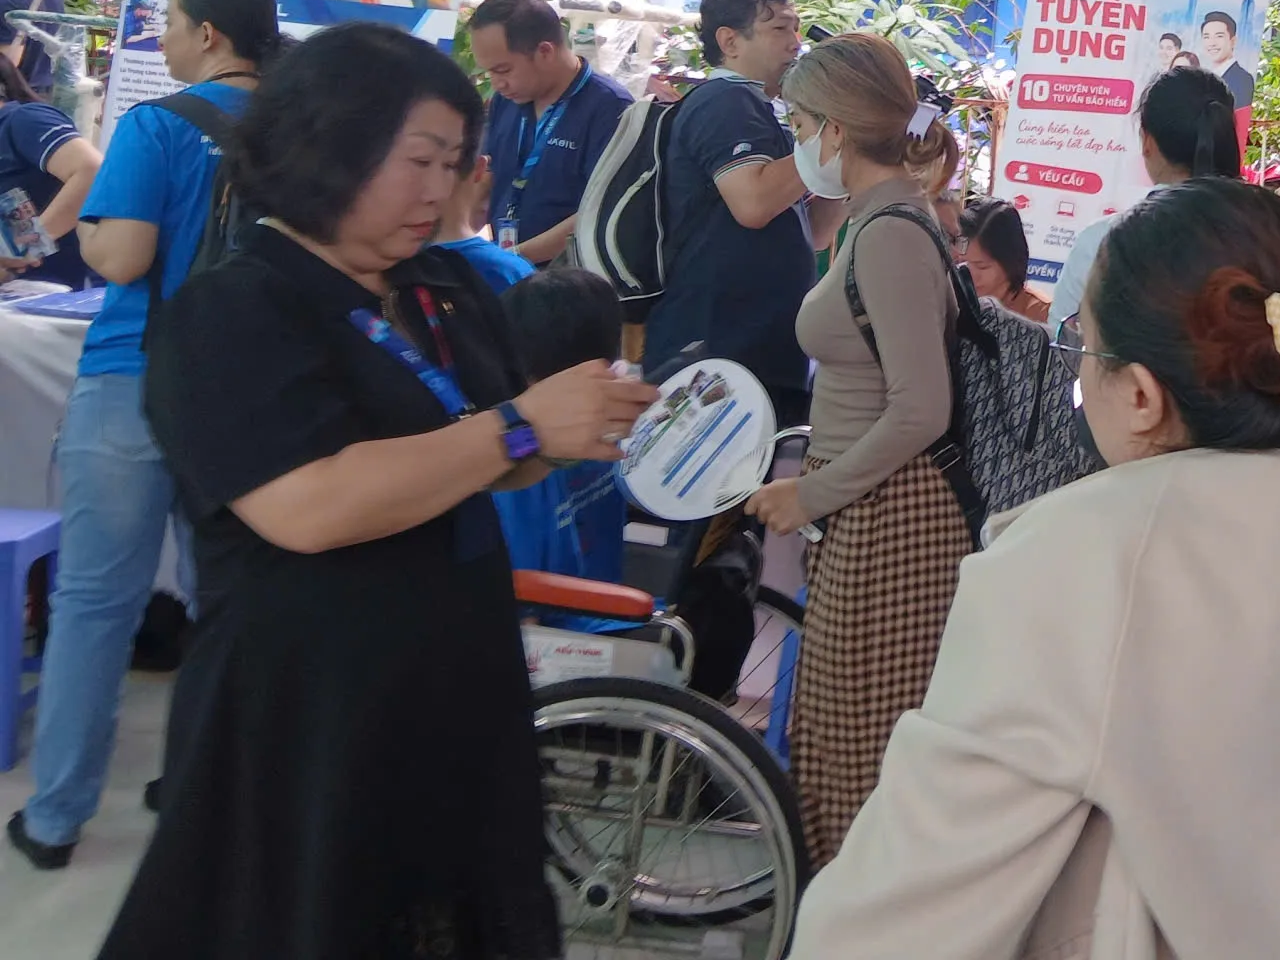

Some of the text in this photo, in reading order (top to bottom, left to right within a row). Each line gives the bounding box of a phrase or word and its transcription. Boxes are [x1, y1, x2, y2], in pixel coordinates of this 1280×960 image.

[1032, 28, 1126, 63] DỤNG
[1022, 80, 1050, 102] 10
[1053, 83, 1110, 96] CHUYÊN VIÊN
[1018, 119, 1044, 136] Cùng
[547, 138, 578, 150] JABIL
[1039, 169, 1085, 187] YÊU CẦU
